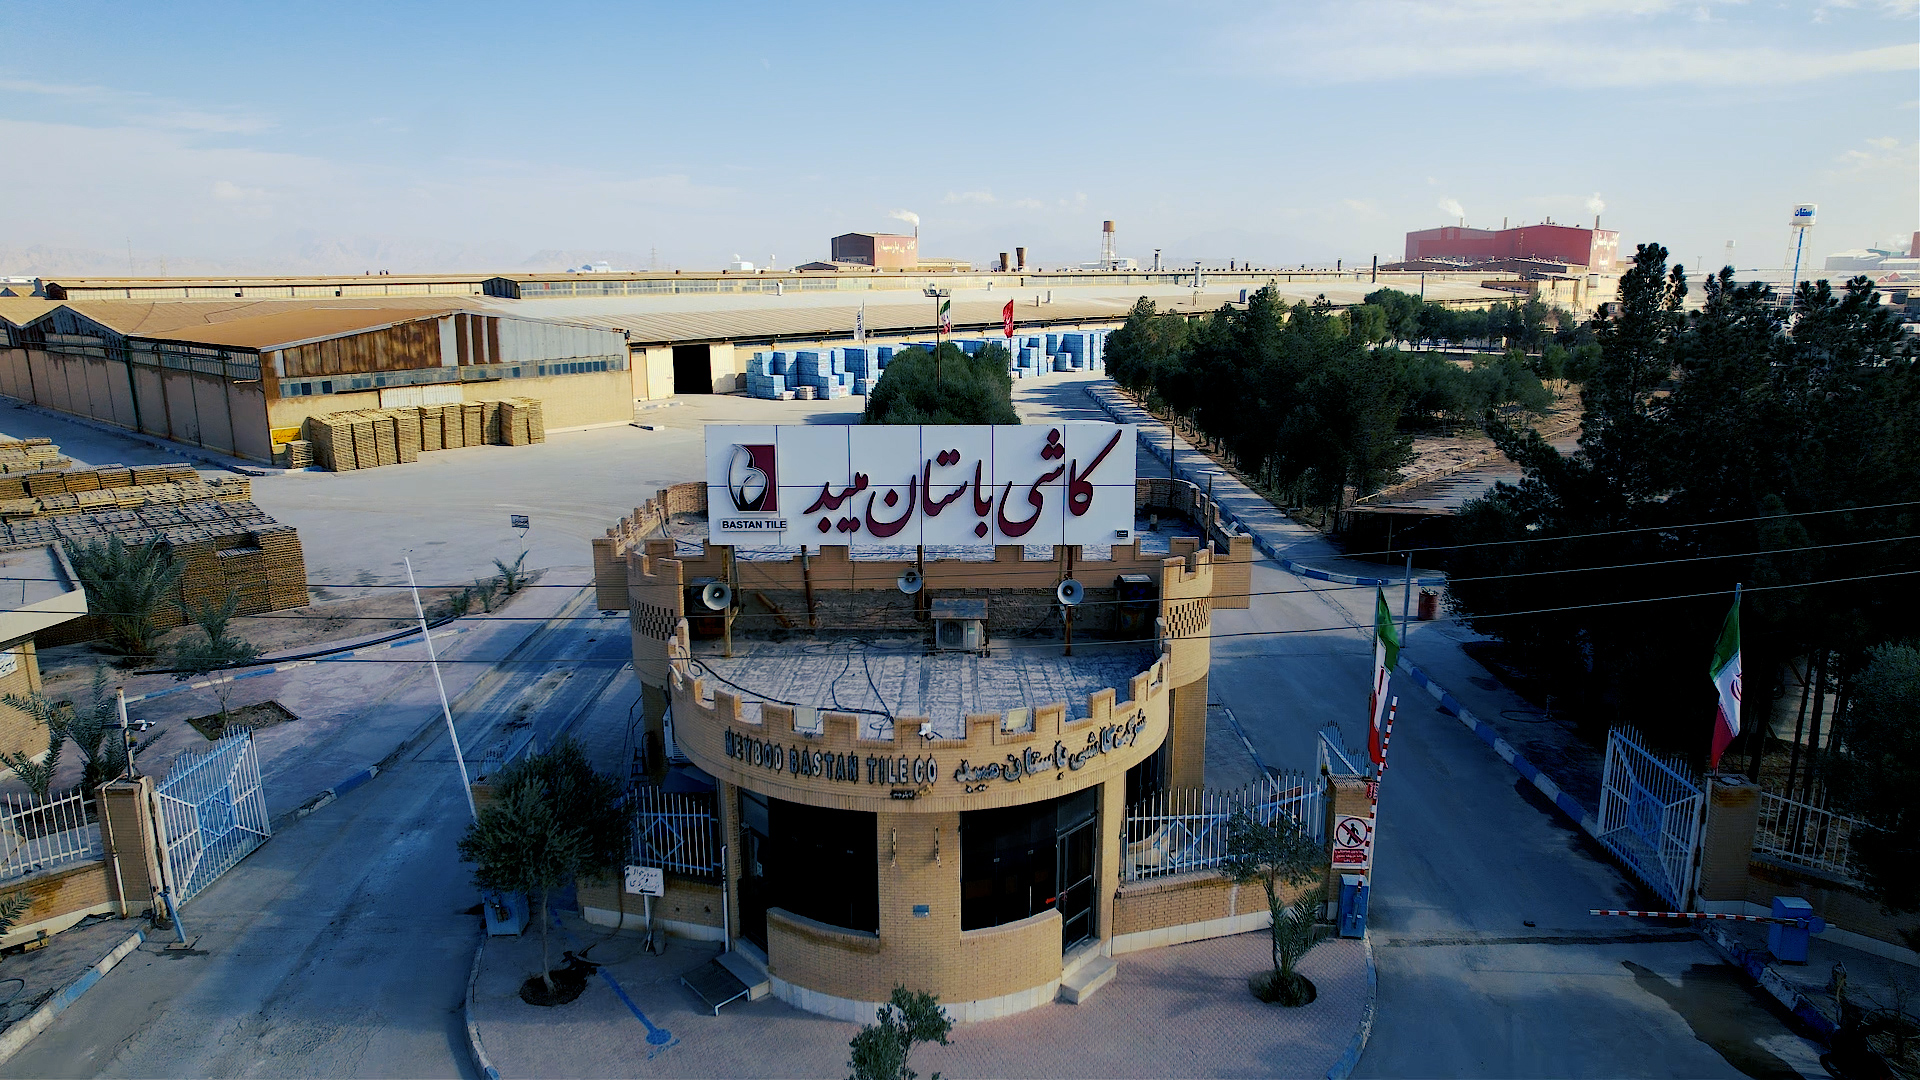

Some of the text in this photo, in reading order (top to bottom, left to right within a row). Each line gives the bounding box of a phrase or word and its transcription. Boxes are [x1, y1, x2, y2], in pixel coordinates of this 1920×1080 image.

[803, 428, 1123, 539] کاشی باستان میبد
[722, 520, 787, 529] BASTAN TILE
[789, 747, 859, 782] BASTAN
[867, 755, 908, 784] TILE
[913, 756, 938, 786] CO
[1002, 741, 1069, 784] باستان
[1068, 723, 1117, 771] کاشی
